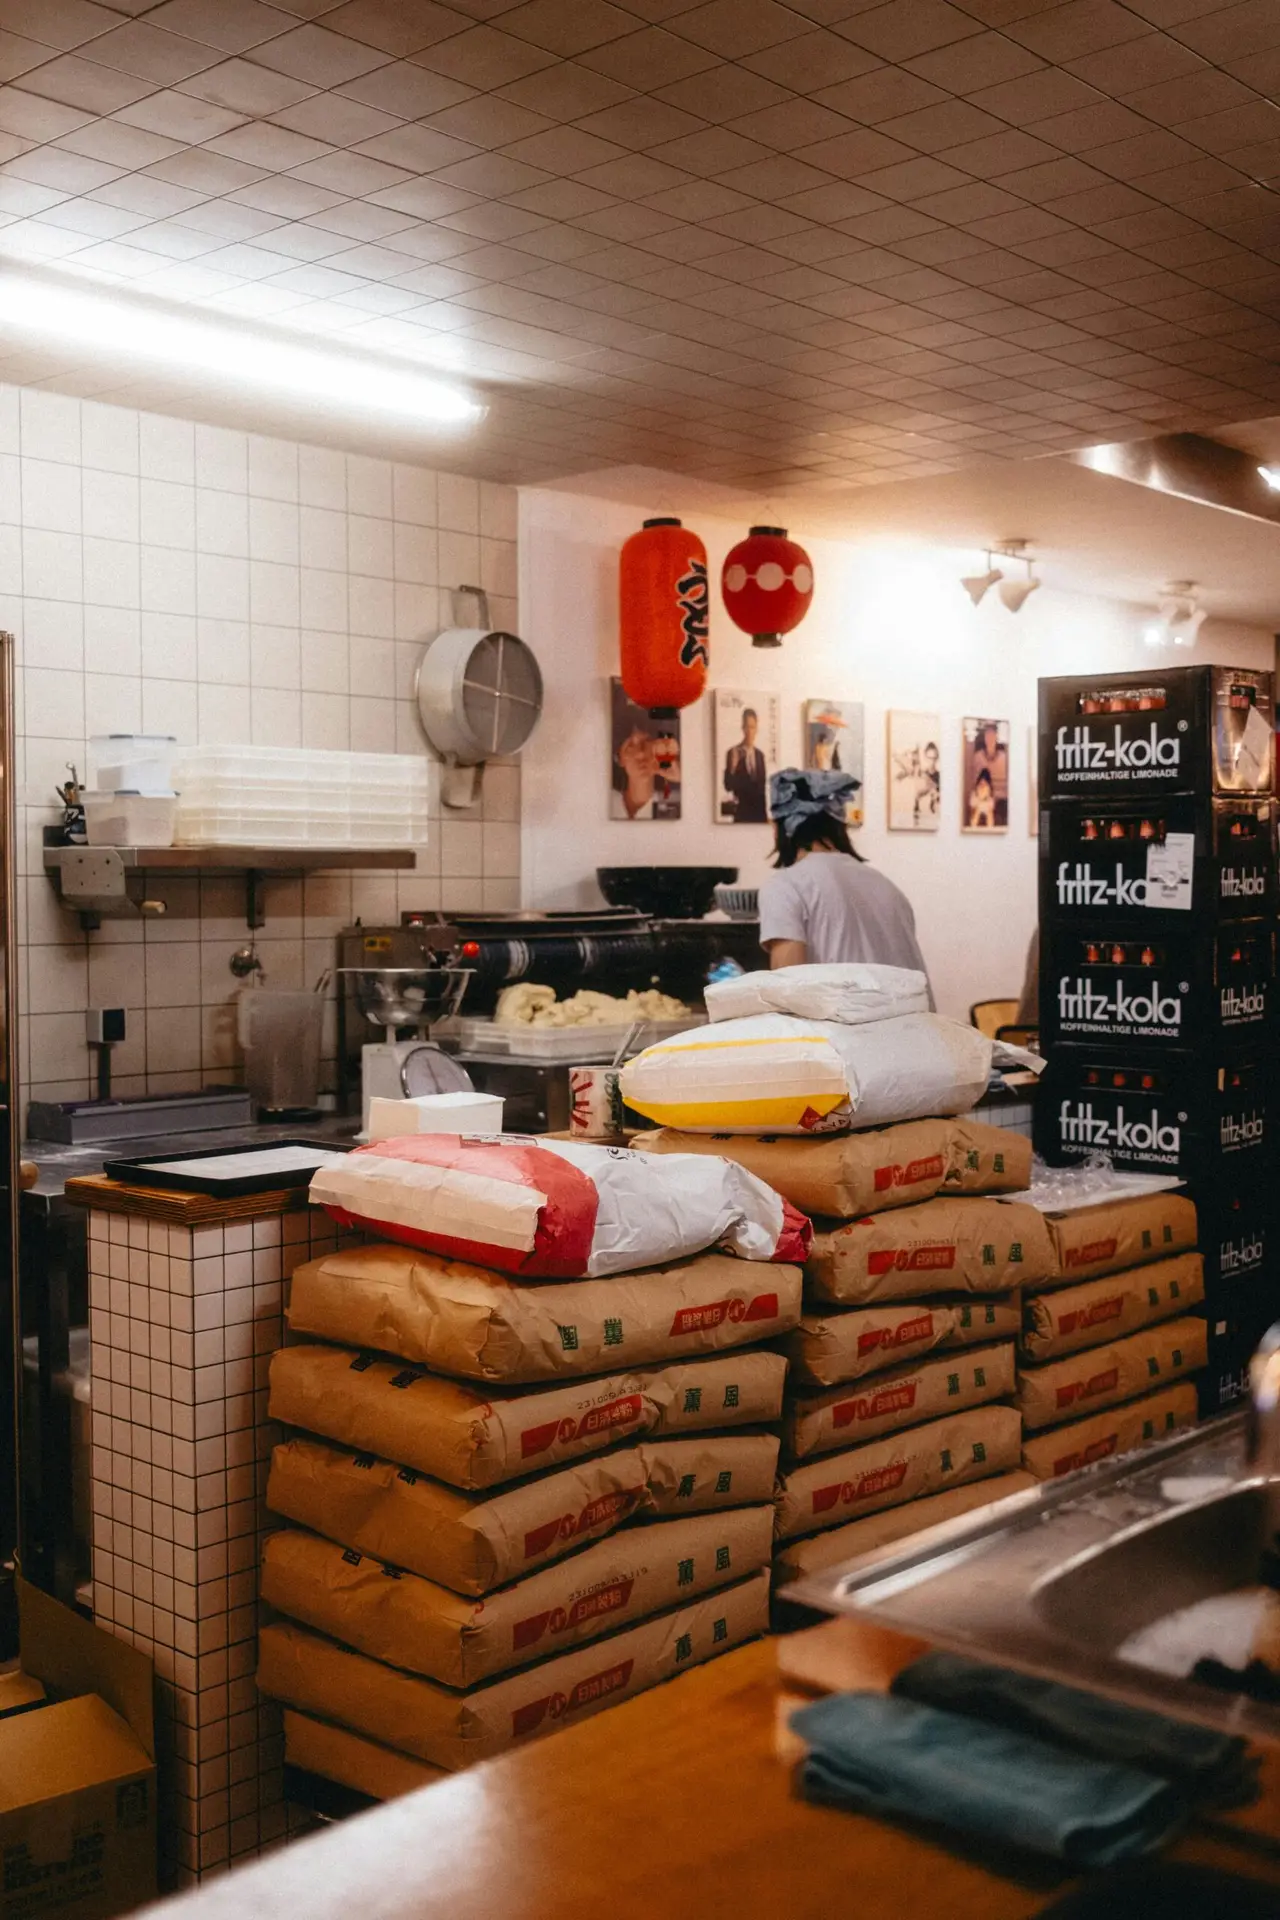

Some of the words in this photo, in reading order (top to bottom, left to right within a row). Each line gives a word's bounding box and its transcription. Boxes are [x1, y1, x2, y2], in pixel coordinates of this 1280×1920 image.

[1055, 721, 1180, 769] fritz-kola
[1057, 770, 1130, 782] KOFFEINHALTIGE
[1131, 768, 1178, 779] LIMONADE
[1056, 861, 1147, 905] fritz-ko
[1057, 976, 1181, 1024] fritz-kola
[1060, 1022, 1131, 1035] KOFFEINHALTIGE
[1133, 1026, 1180, 1037] LIMONADE
[1058, 1100, 1180, 1152] fritz-kola
[1133, 1152, 1180, 1164] LIMONADE
